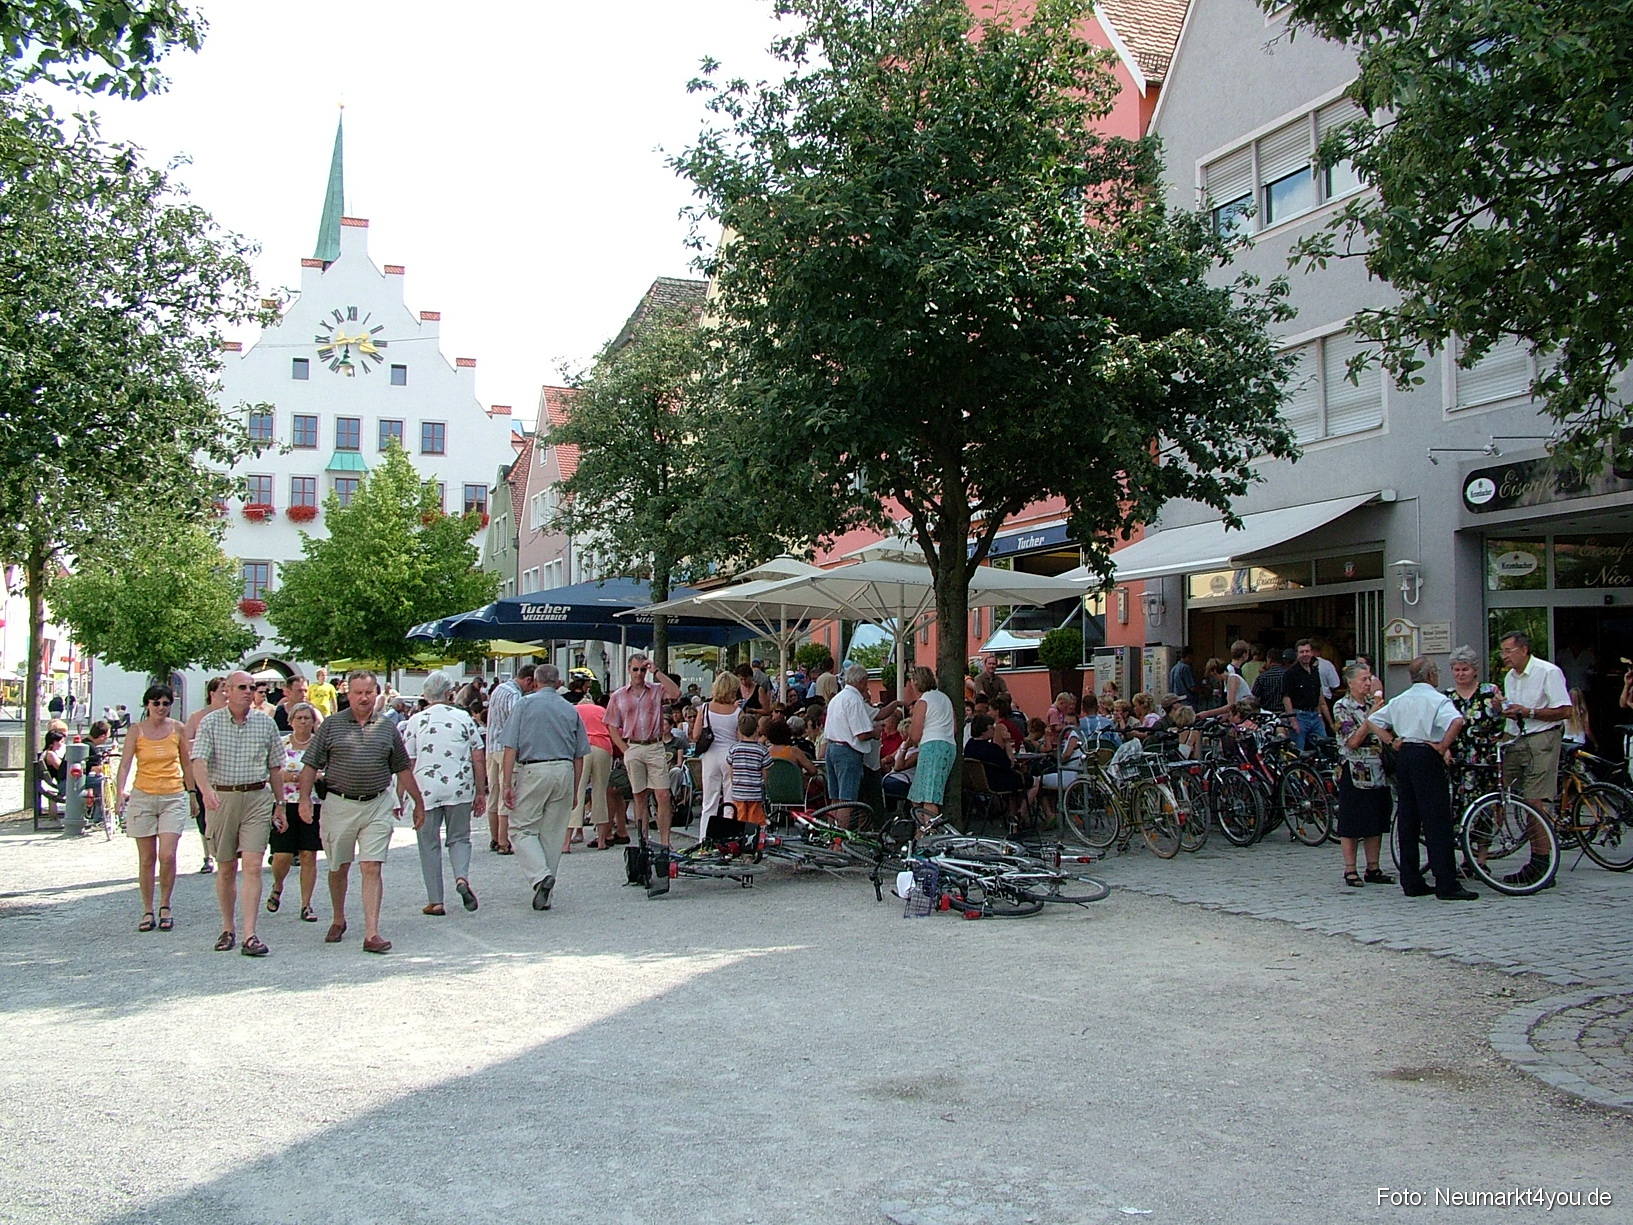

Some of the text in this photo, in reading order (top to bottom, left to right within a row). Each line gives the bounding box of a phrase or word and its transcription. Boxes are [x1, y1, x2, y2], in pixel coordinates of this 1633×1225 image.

[1017, 535, 1046, 550] Tucher
[1501, 561, 1533, 569] Krombacher
[1584, 565, 1632, 586] Nico
[520, 603, 571, 614] Tucher
